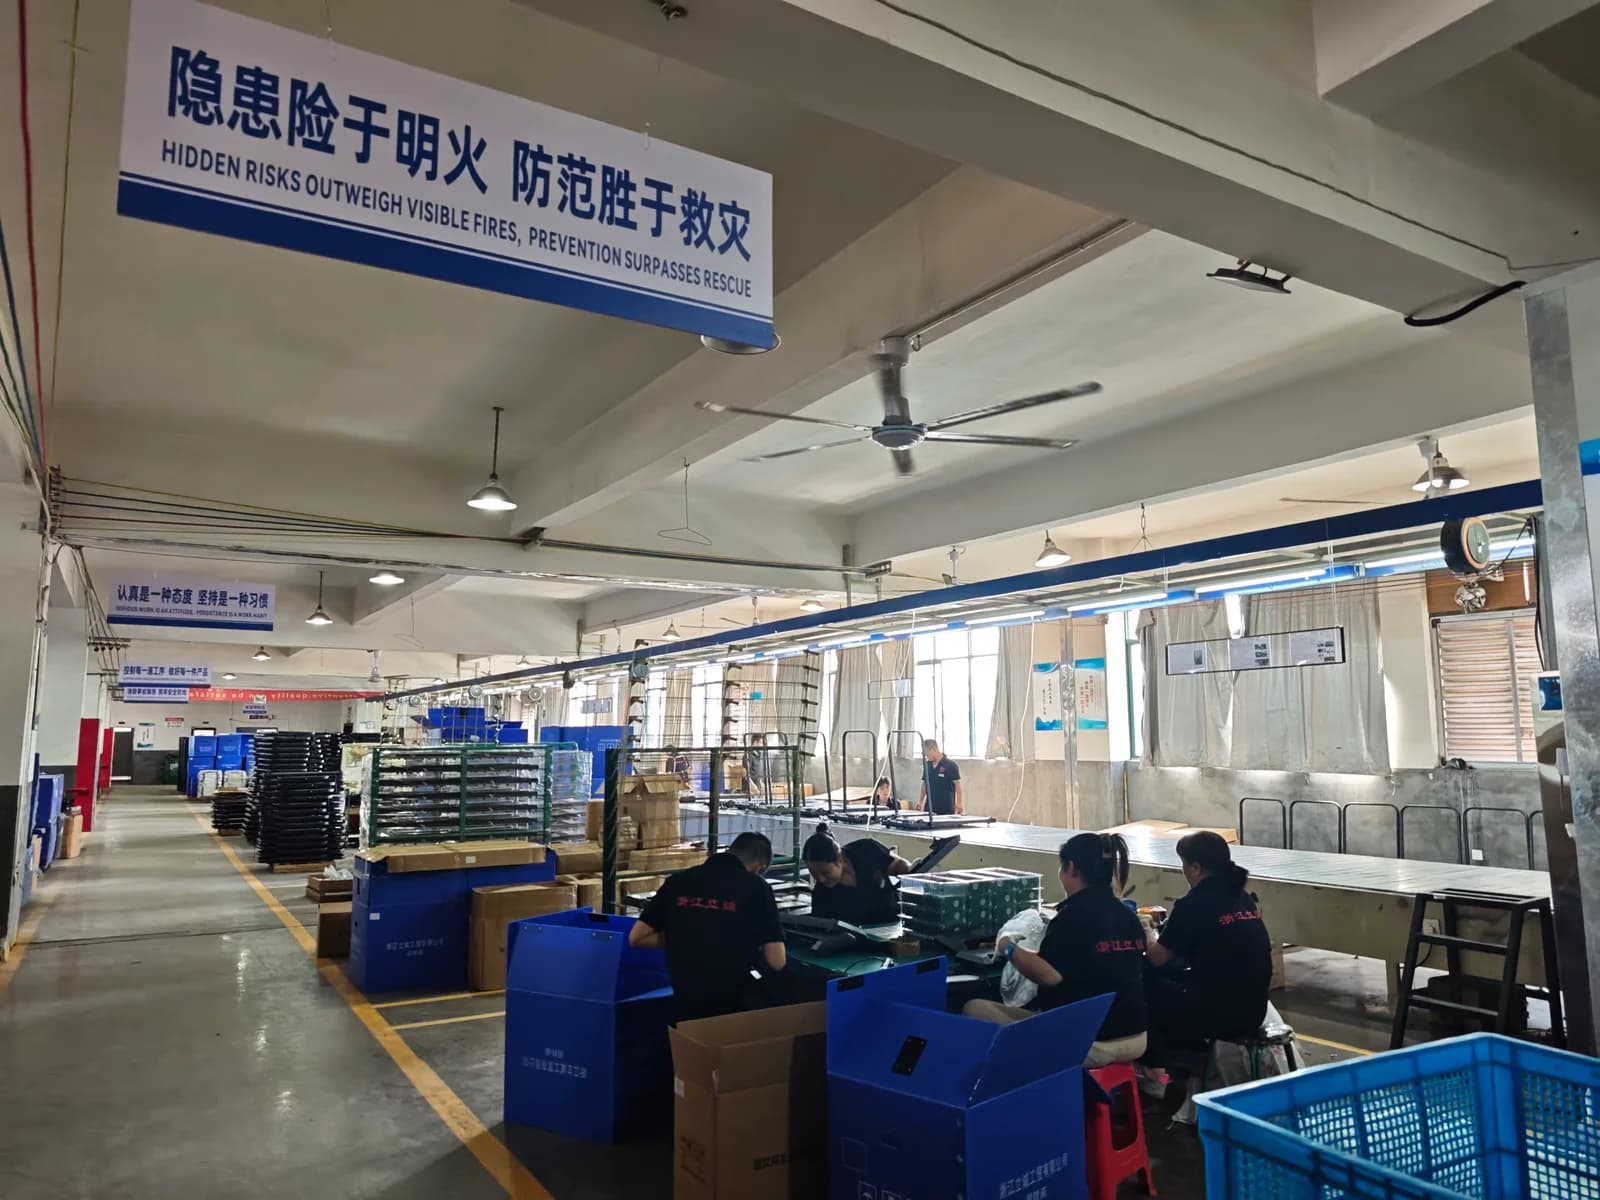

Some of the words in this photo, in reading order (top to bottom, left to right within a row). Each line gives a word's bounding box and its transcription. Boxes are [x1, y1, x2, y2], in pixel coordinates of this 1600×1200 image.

[161, 139, 240, 178] HIDDEN
[246, 159, 302, 192] RISKS
[305, 174, 402, 215] OUTWEIGH
[407, 196, 469, 231] VISIBLE
[473, 213, 521, 248] FIRES,
[529, 226, 622, 267] PREVENTION
[624, 250, 701, 285] SURPASSES
[703, 269, 752, 298] RESCUE
[168, 46, 488, 193] 隐患险于明火
[512, 140, 751, 262] 防范胜于救灾
[118, 584, 193, 605] 认真是一种态度
[198, 589, 269, 609] 坚持是一种习惯
